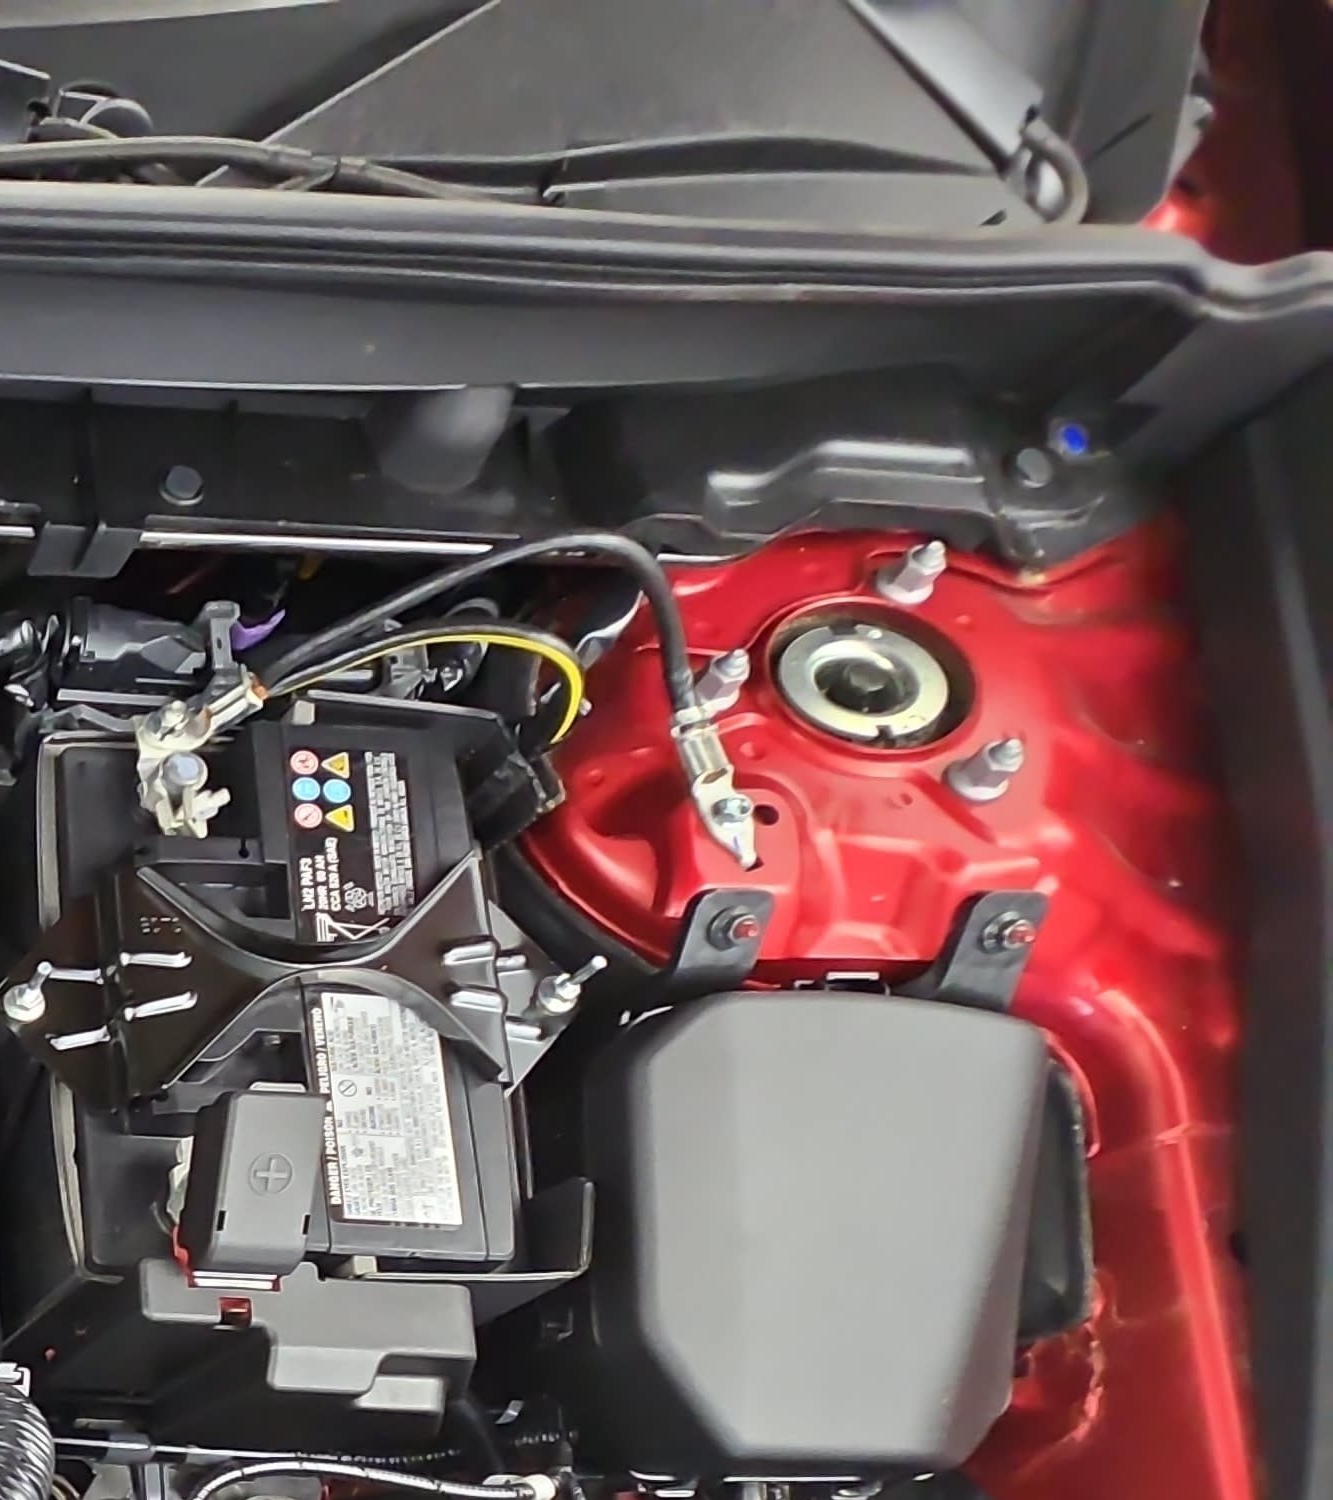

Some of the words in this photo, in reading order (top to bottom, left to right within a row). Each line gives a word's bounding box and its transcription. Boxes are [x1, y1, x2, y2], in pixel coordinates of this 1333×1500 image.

[330, 889, 341, 911] CCA
[310, 1007, 326, 1047] VENENO
[315, 1052, 331, 1094] PELIGRO
[324, 1116, 337, 1155] POISON
[327, 1161, 342, 1205] DANGER
